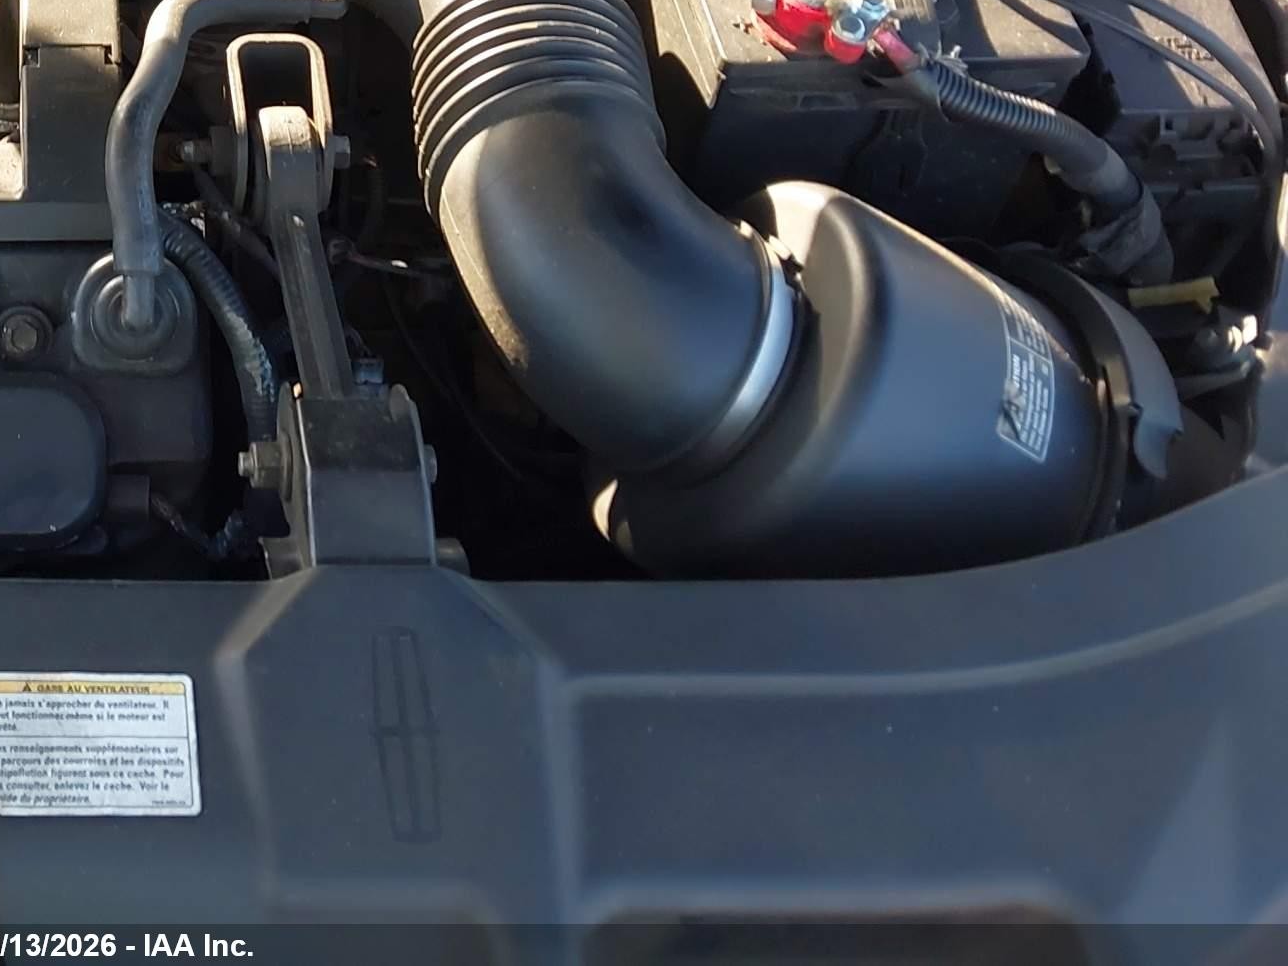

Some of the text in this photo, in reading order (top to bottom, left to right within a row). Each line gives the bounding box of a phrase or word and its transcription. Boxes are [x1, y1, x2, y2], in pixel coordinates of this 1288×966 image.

[67, 684, 81, 693] AU
[84, 685, 150, 695] VENTILATEUR
[5, 698, 35, 709] jamais
[38, 699, 92, 710] s'approcher
[94, 700, 105, 709] du
[96, 712, 104, 721] si
[107, 712, 115, 721] le
[118, 712, 150, 721] moteur
[152, 712, 166, 721] est
[10, 743, 82, 754] renseignements
[165, 746, 179, 754] sur
[1, 757, 41, 767] parcours
[44, 756, 60, 765] des
[121, 756, 134, 766] les
[113, 770, 124, 778] ce
[163, 769, 184, 779] Pour
[92, 781, 100, 790] le
[139, 781, 158, 791] Voir
[161, 782, 169, 791] le
